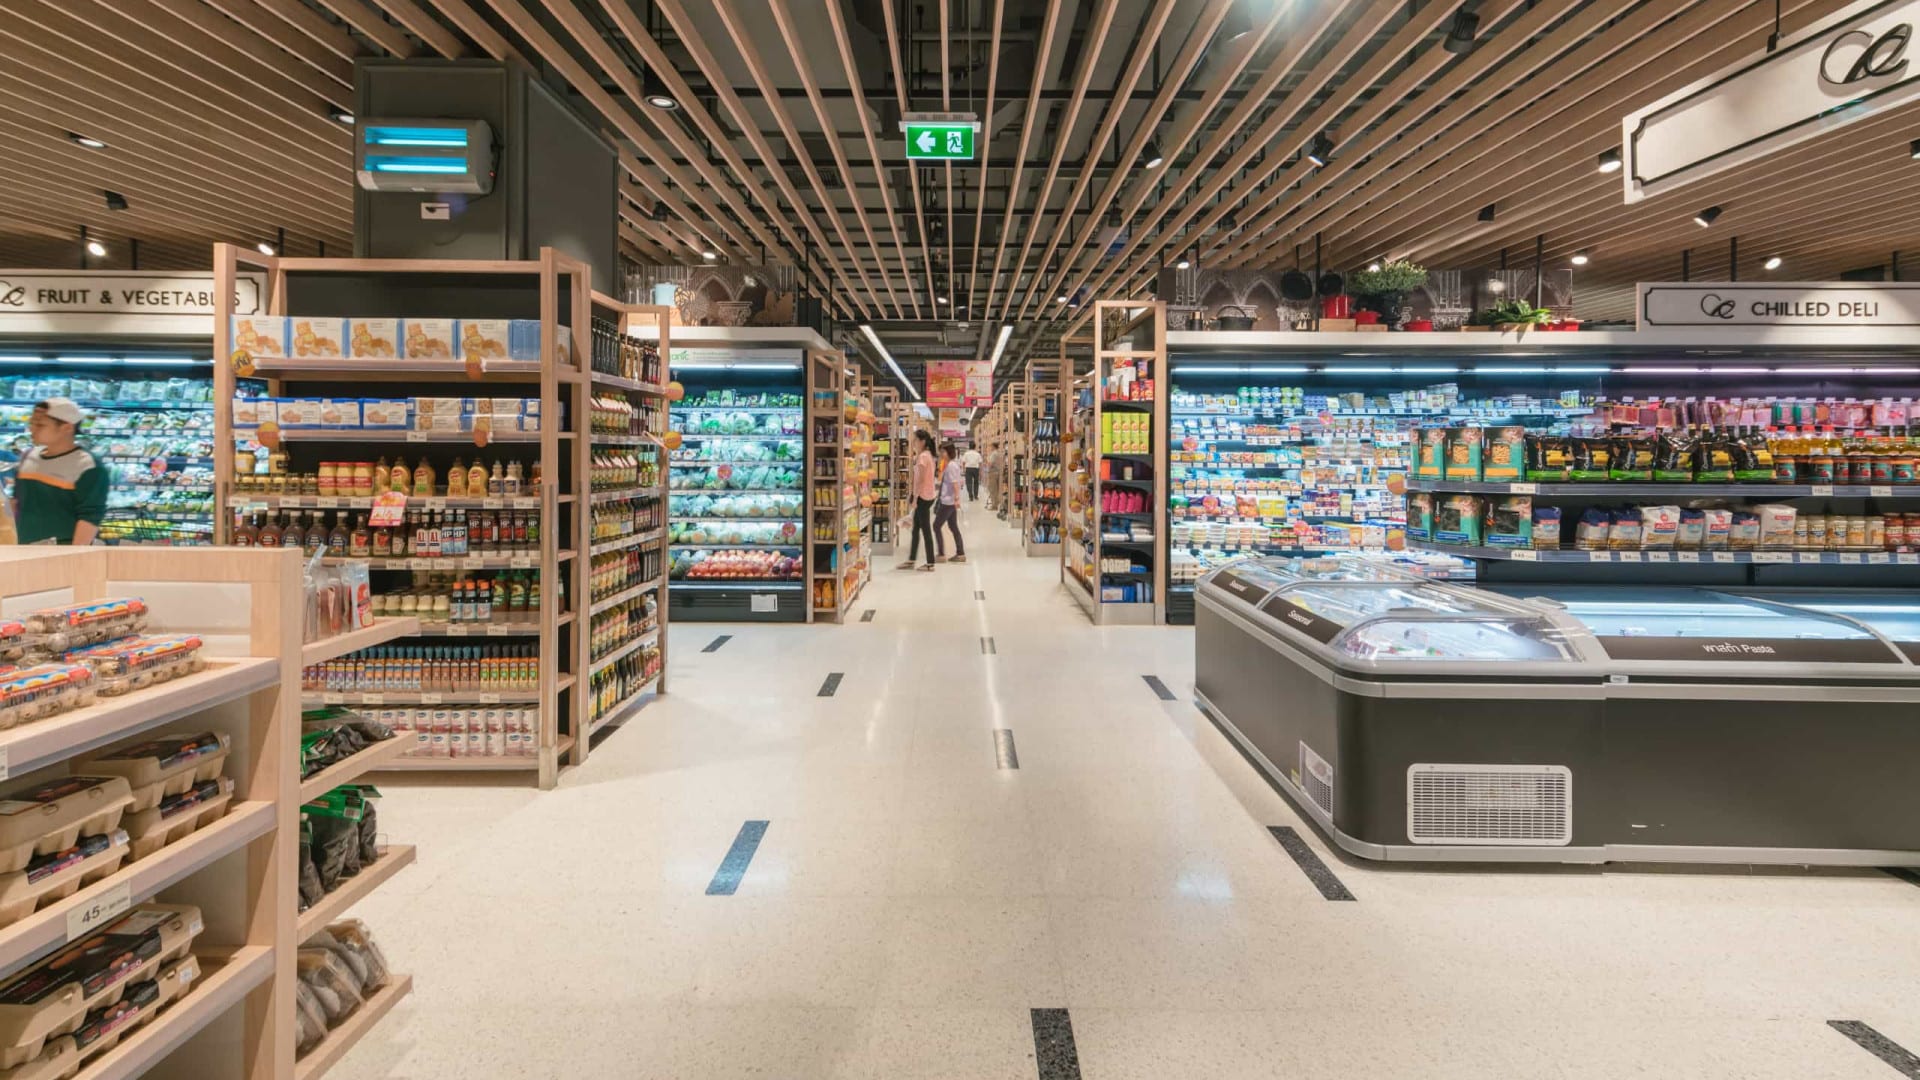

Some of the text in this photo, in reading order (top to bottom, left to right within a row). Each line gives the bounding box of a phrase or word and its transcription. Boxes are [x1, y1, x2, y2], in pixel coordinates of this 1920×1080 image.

[37, 289, 91, 304] FRUIT
[99, 290, 112, 305] &
[122, 290, 241, 307] VEGETABLS
[1751, 301, 1879, 317] CHILLED DELI
[441, 530, 453, 538] HP
[453, 530, 465, 538] HP
[1740, 644, 1777, 654] Pasta
